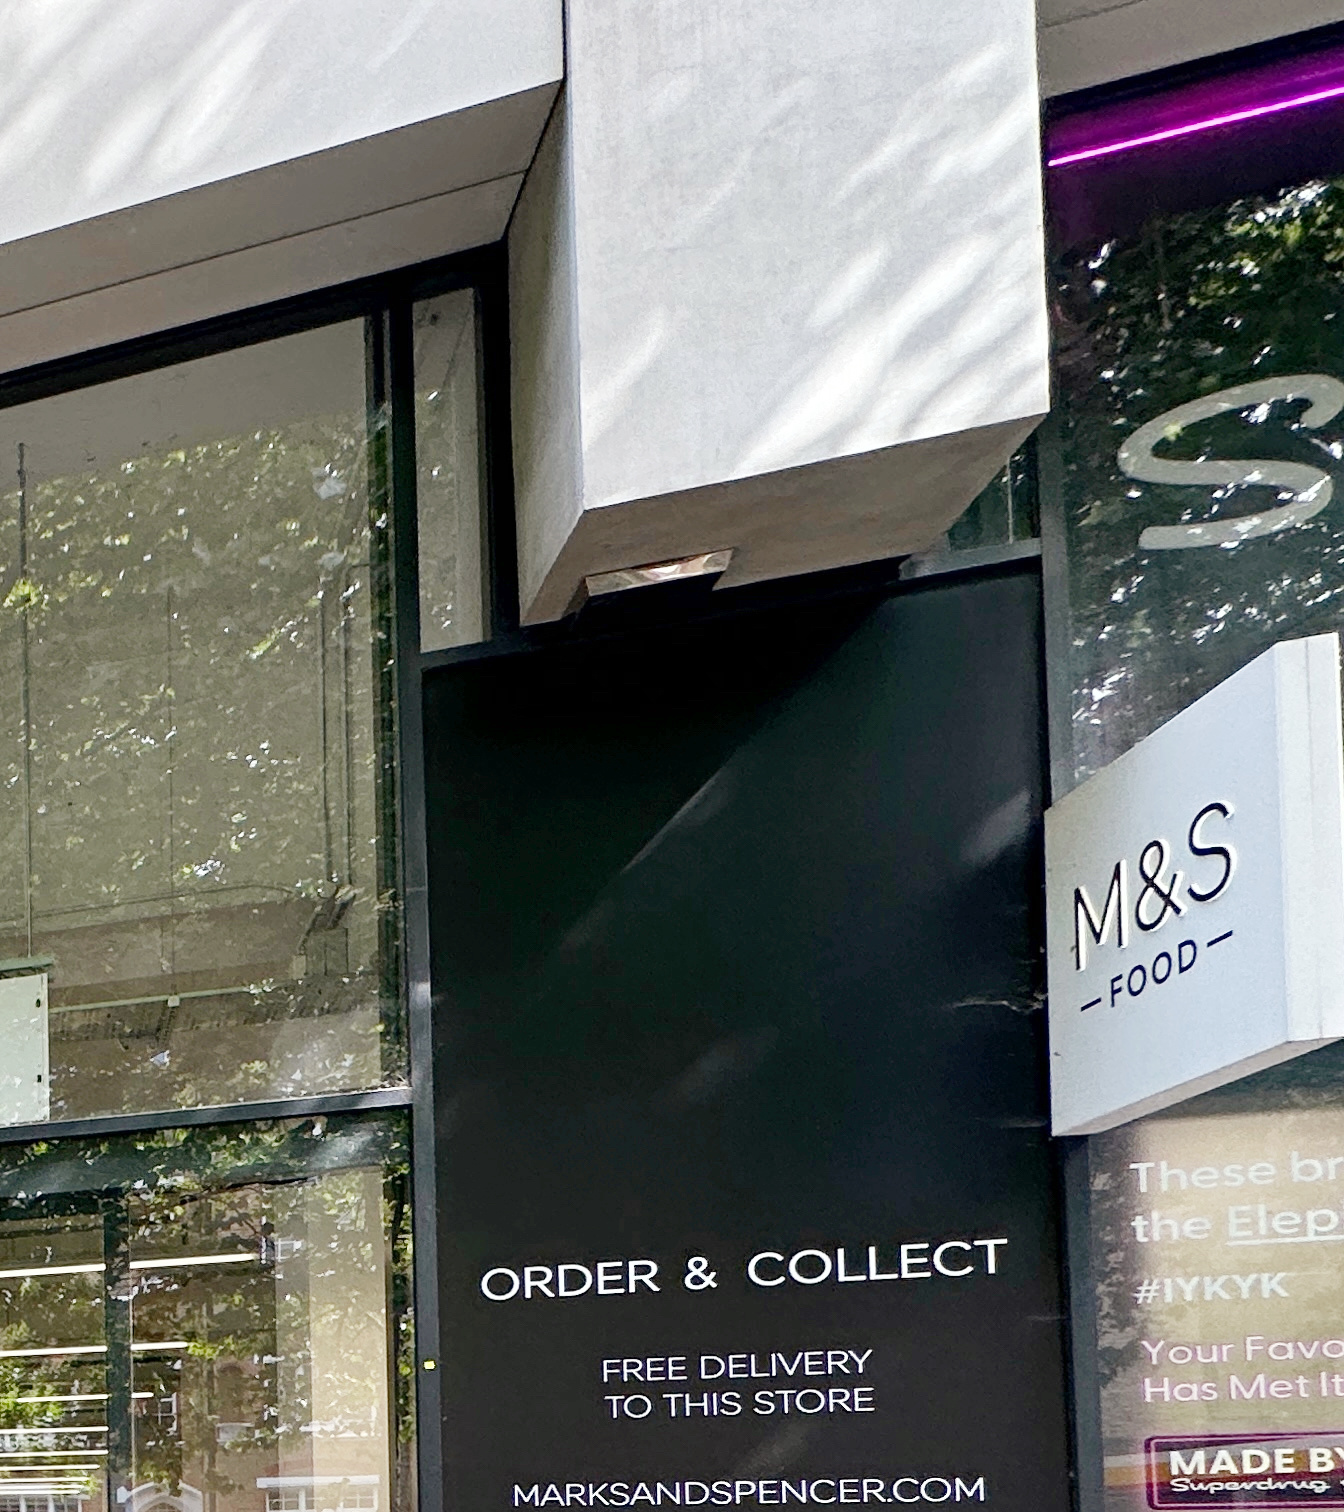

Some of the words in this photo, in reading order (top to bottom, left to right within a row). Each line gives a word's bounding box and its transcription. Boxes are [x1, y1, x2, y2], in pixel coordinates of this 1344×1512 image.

[1117, 373, 1344, 551] S
[1073, 801, 1236, 973] M&S
[1110, 938, 1198, 1009] FOOD
[1130, 1158, 1276, 1195] These
[1290, 1150, 1344, 1183] br
[1131, 1210, 1212, 1244] the
[1227, 1201, 1344, 1242] Elep
[480, 1259, 661, 1301] ORDER
[683, 1256, 719, 1291] &
[746, 1237, 1010, 1288] COLLECT
[1134, 1271, 1290, 1305] #IYKYK
[601, 1356, 688, 1384] FREE
[699, 1348, 874, 1381] DELIVERY
[1141, 1337, 1234, 1366] Your
[1245, 1333, 1344, 1362] Favo
[605, 1393, 653, 1420] TO
[662, 1390, 742, 1418] THIS
[752, 1387, 876, 1416] STORE
[1143, 1375, 1219, 1403] Has
[1229, 1371, 1310, 1401] Met
[1168, 1448, 1298, 1476] MADE
[512, 1476, 987, 1509] MARKSANDSPENCER.COM
[1170, 1478, 1332, 1495] Superdrug
